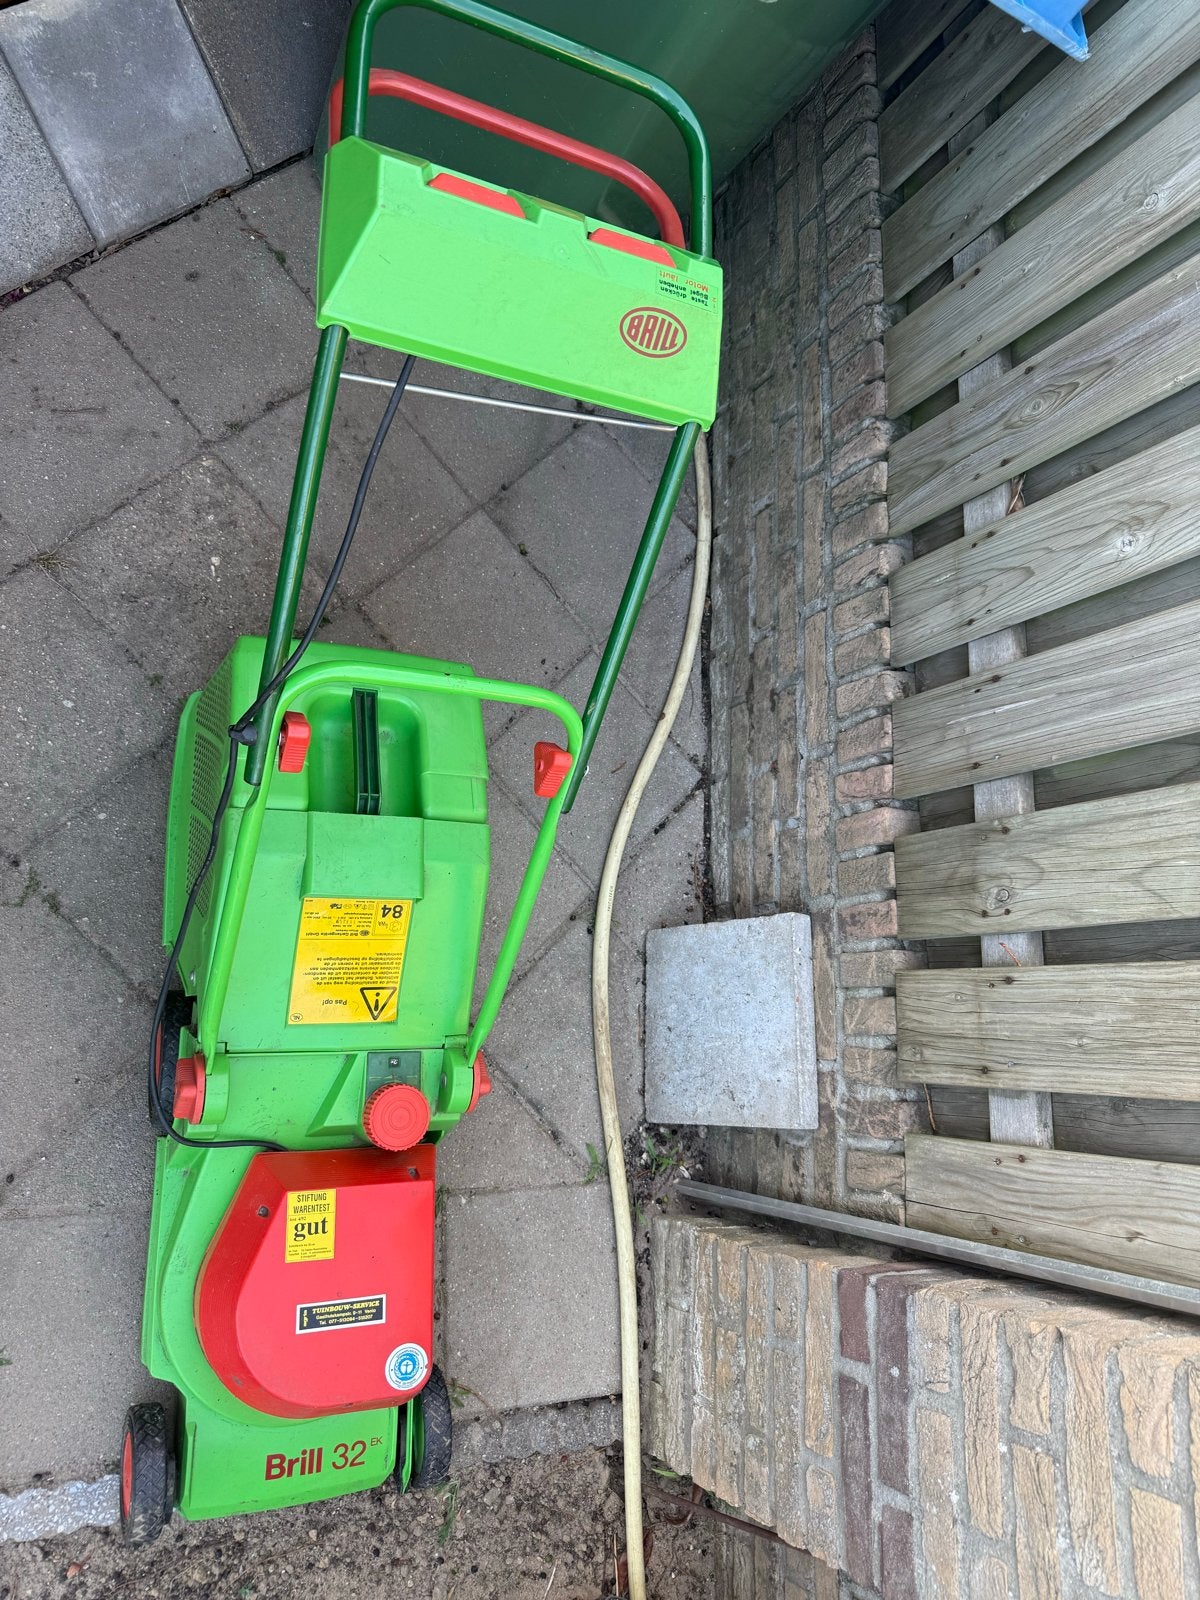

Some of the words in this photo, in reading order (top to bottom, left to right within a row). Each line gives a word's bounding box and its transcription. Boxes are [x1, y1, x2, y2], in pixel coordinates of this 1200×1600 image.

[659, 270, 678, 283] läuft
[659, 279, 687, 292] anheben
[685, 279, 709, 293] Motor
[660, 286, 687, 299] drücken
[690, 289, 708, 300] Bügel
[691, 296, 708, 307] Taste
[626, 314, 679, 351] BRILL
[381, 904, 404, 919] 84
[322, 998, 334, 1006] op!
[296, 1192, 327, 1203] STIFTUNG
[293, 1203, 331, 1214] WARENTEST
[293, 1216, 329, 1242] gut
[311, 1299, 381, 1315] TUINBOUW-SERVICE
[264, 1446, 324, 1481] Brill
[331, 1439, 367, 1471] 32
[370, 1435, 383, 1447] EK
